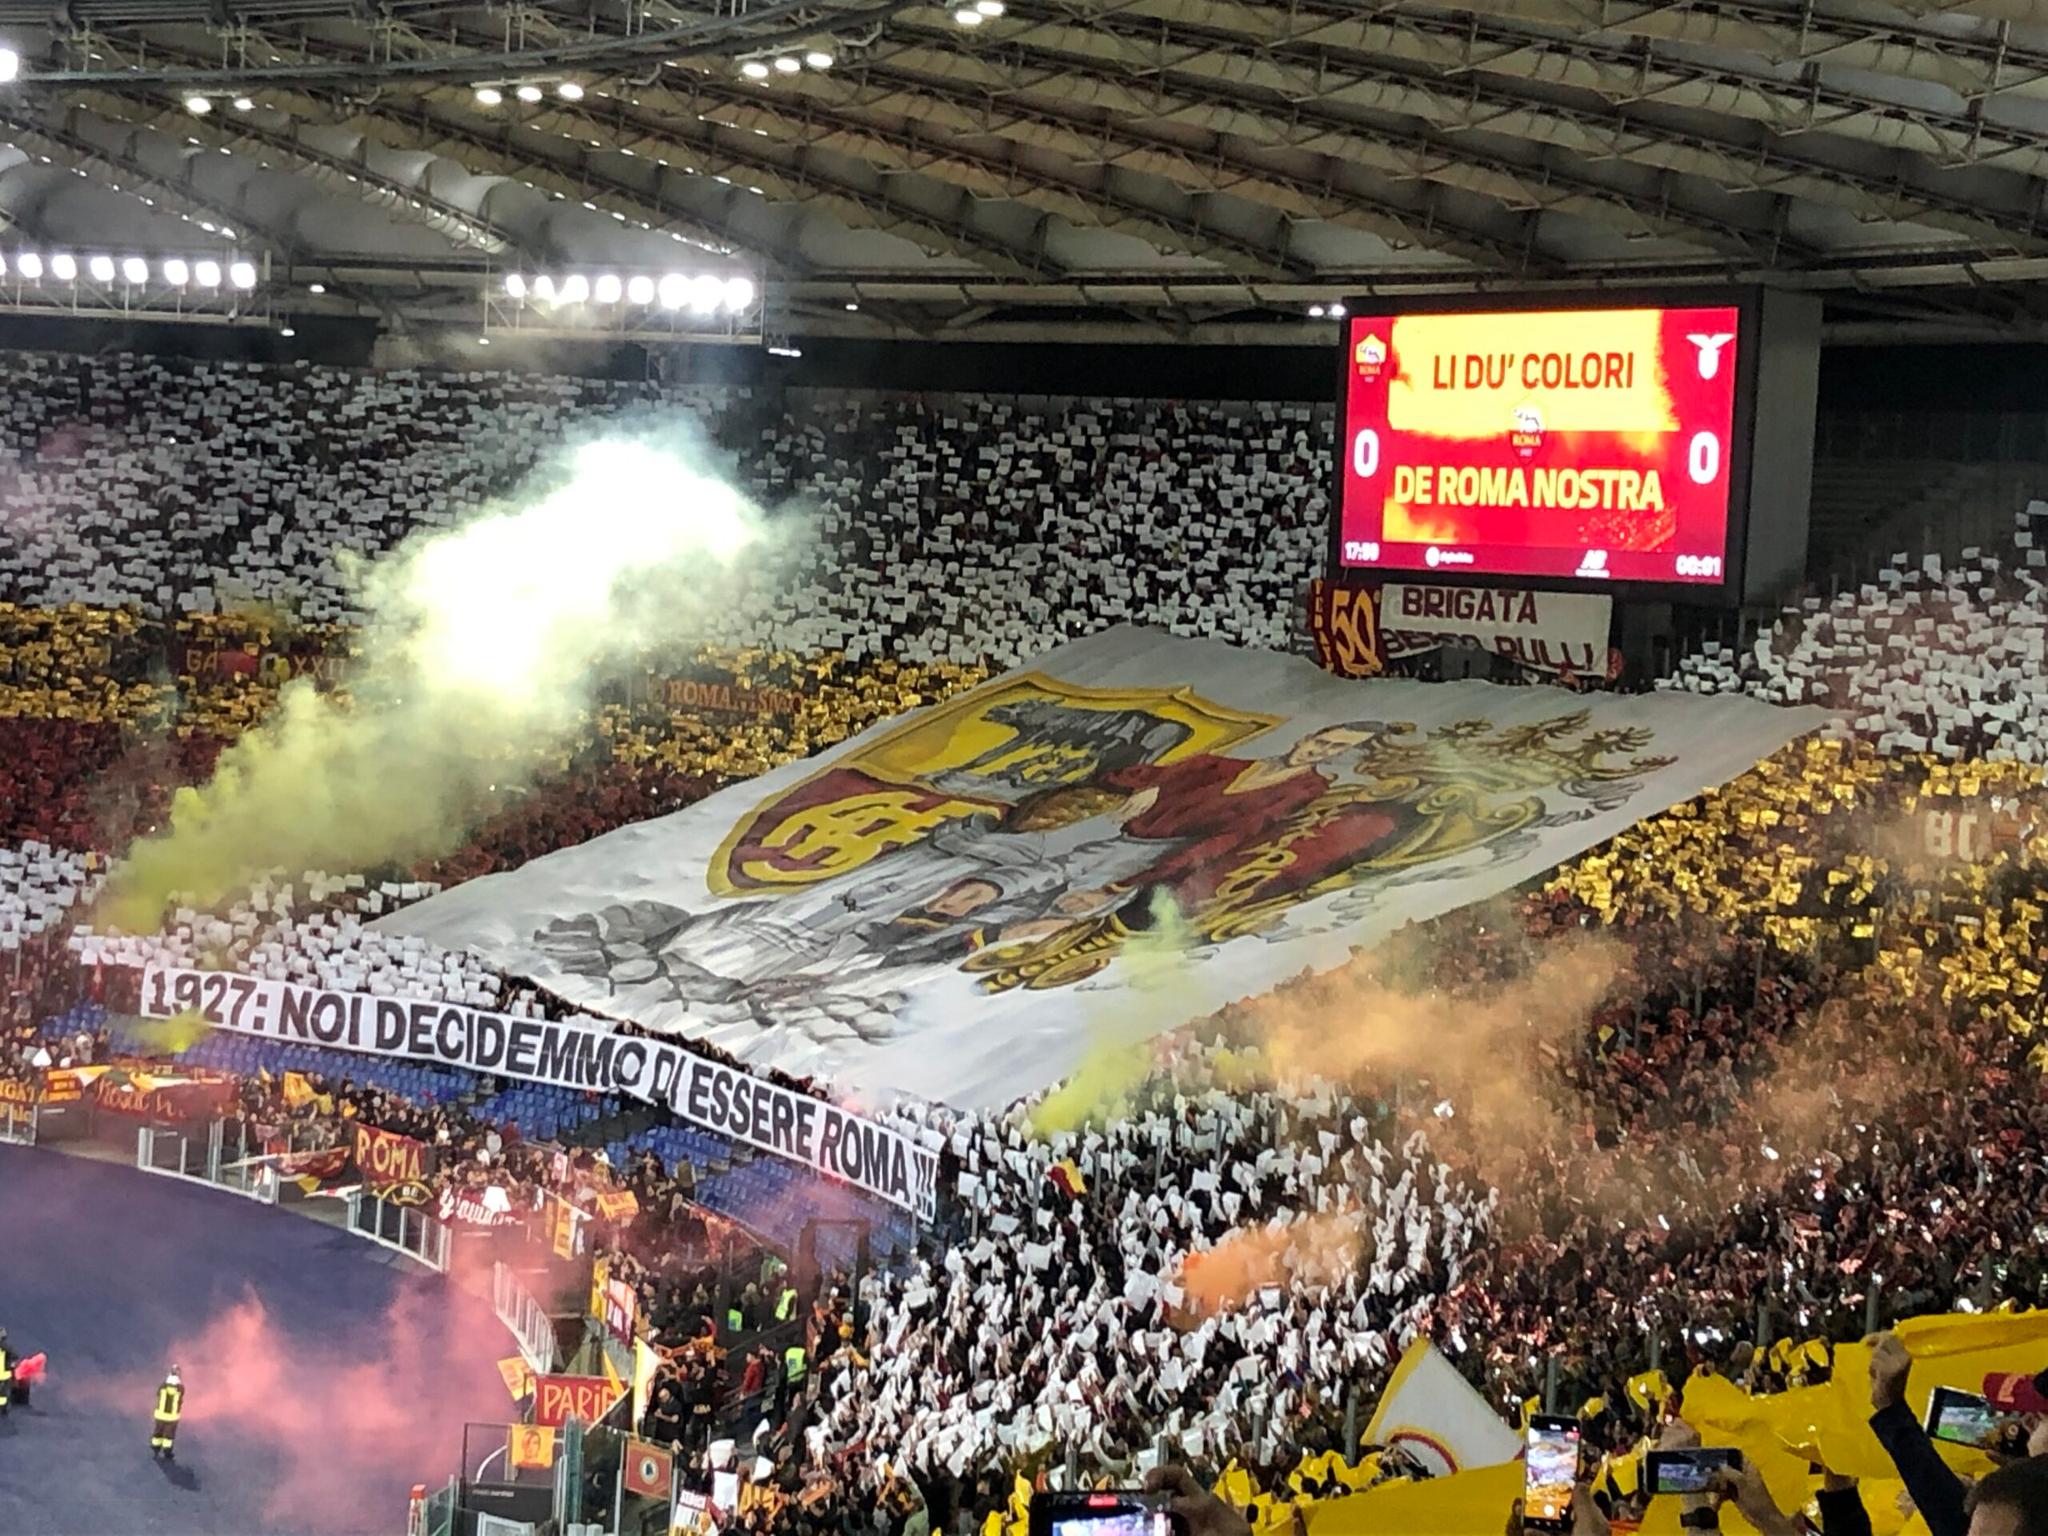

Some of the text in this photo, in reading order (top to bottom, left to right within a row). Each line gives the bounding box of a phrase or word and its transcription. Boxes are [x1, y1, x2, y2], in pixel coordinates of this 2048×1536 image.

[1433, 351, 1634, 390] LI DU' COLORI
[1354, 428, 1379, 478] 0
[1688, 431, 1719, 485] 0
[1394, 465, 1664, 512] DE ROMA NOSTRA
[1402, 586, 1538, 625] BRIGATA
[668, 679, 731, 711] ROMA
[148, 970, 269, 1031] 1927:
[279, 986, 363, 1046] NOI
[375, 999, 648, 1088] DECIDEMMO
[648, 1047, 686, 1108] DI
[688, 1060, 817, 1162] ESSERE
[819, 1109, 912, 1206] ROMA
[356, 1127, 421, 1182] ROMA
